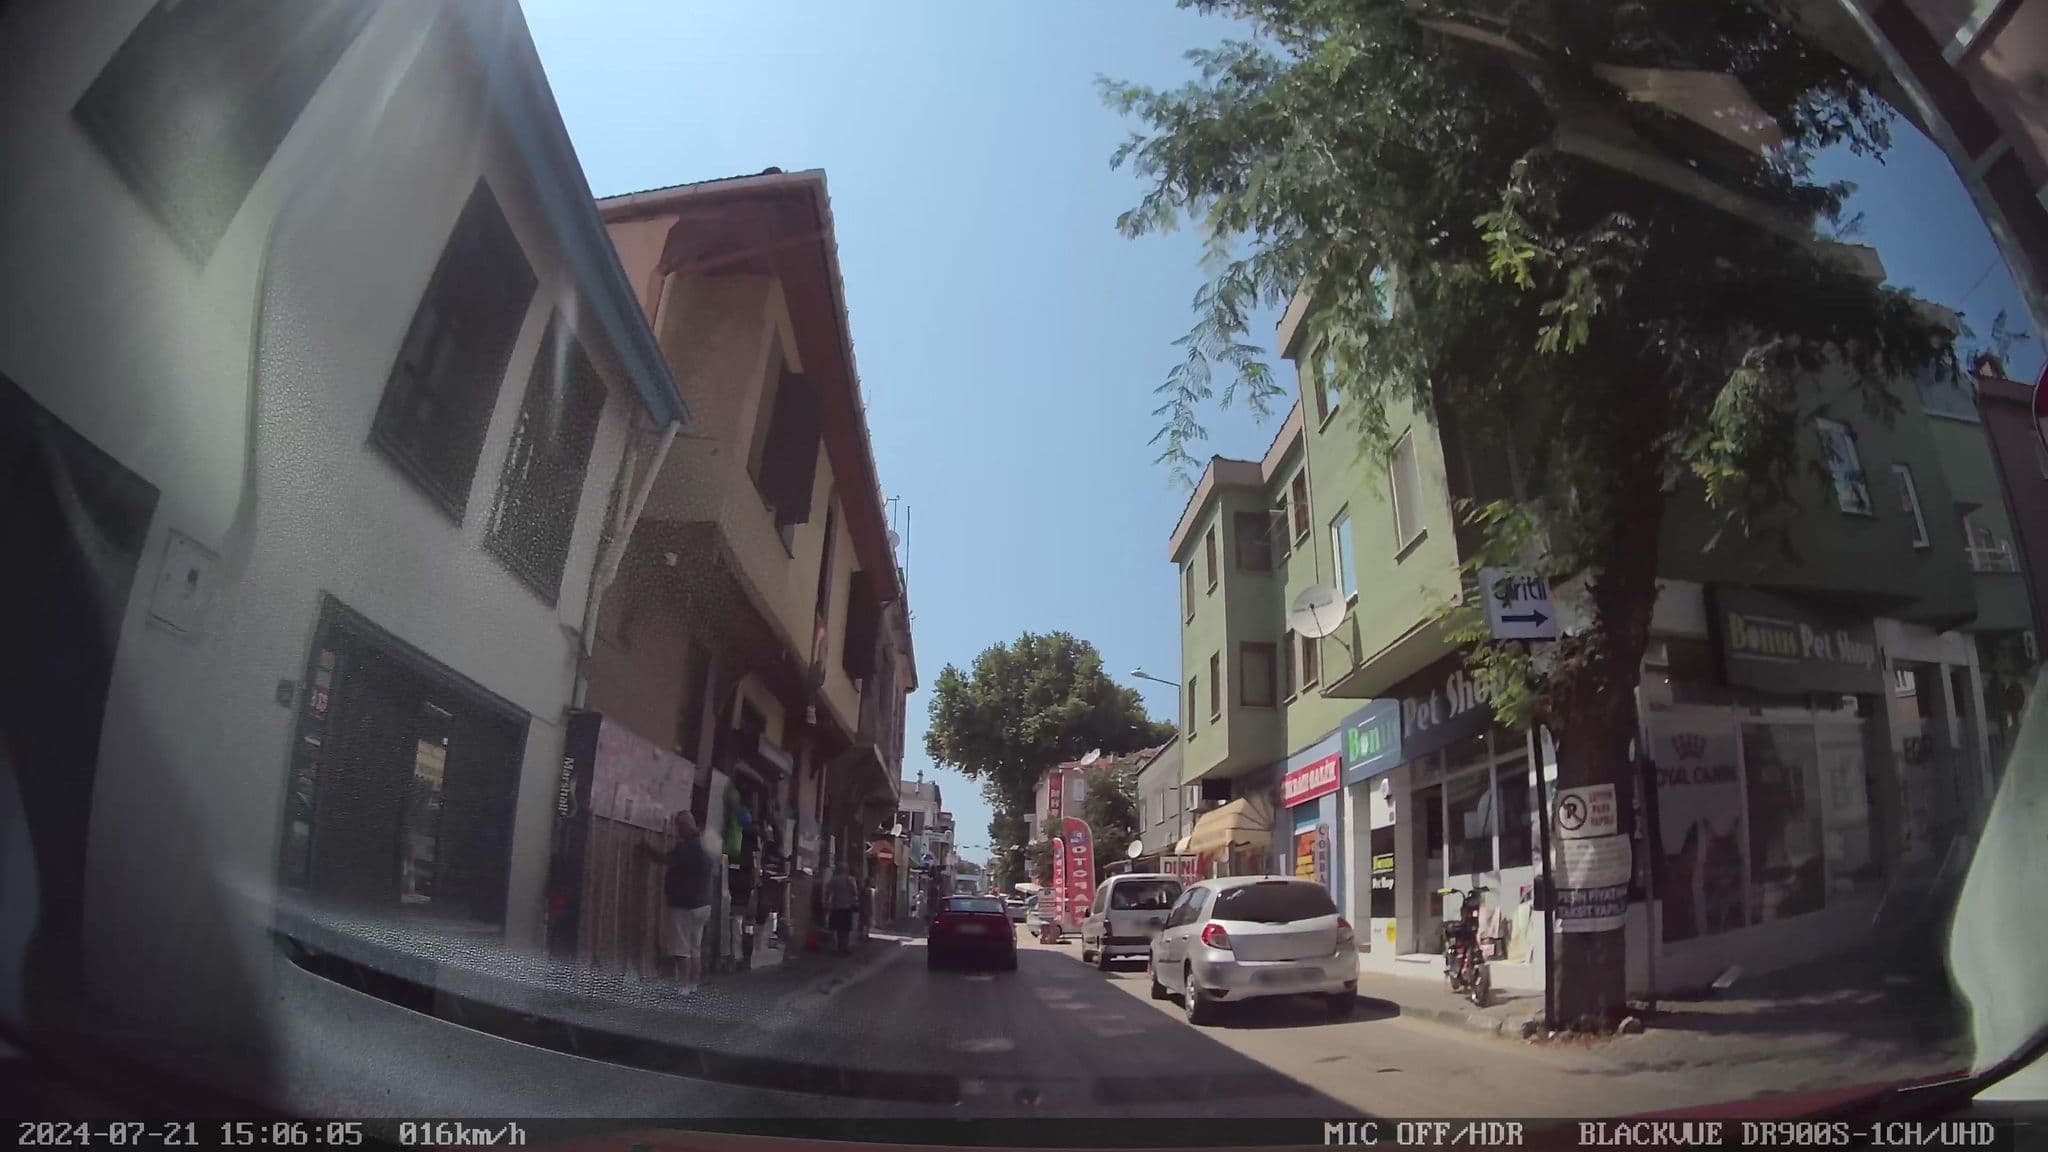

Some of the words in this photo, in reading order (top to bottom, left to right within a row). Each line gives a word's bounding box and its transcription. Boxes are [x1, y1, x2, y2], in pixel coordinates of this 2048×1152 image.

[1728, 611, 1798, 657] Bonus
[1799, 623, 1834, 662] Pet
[1836, 630, 1875, 671] Shop
[1403, 689, 1440, 738] Pet
[558, 757, 575, 812] Marshall
